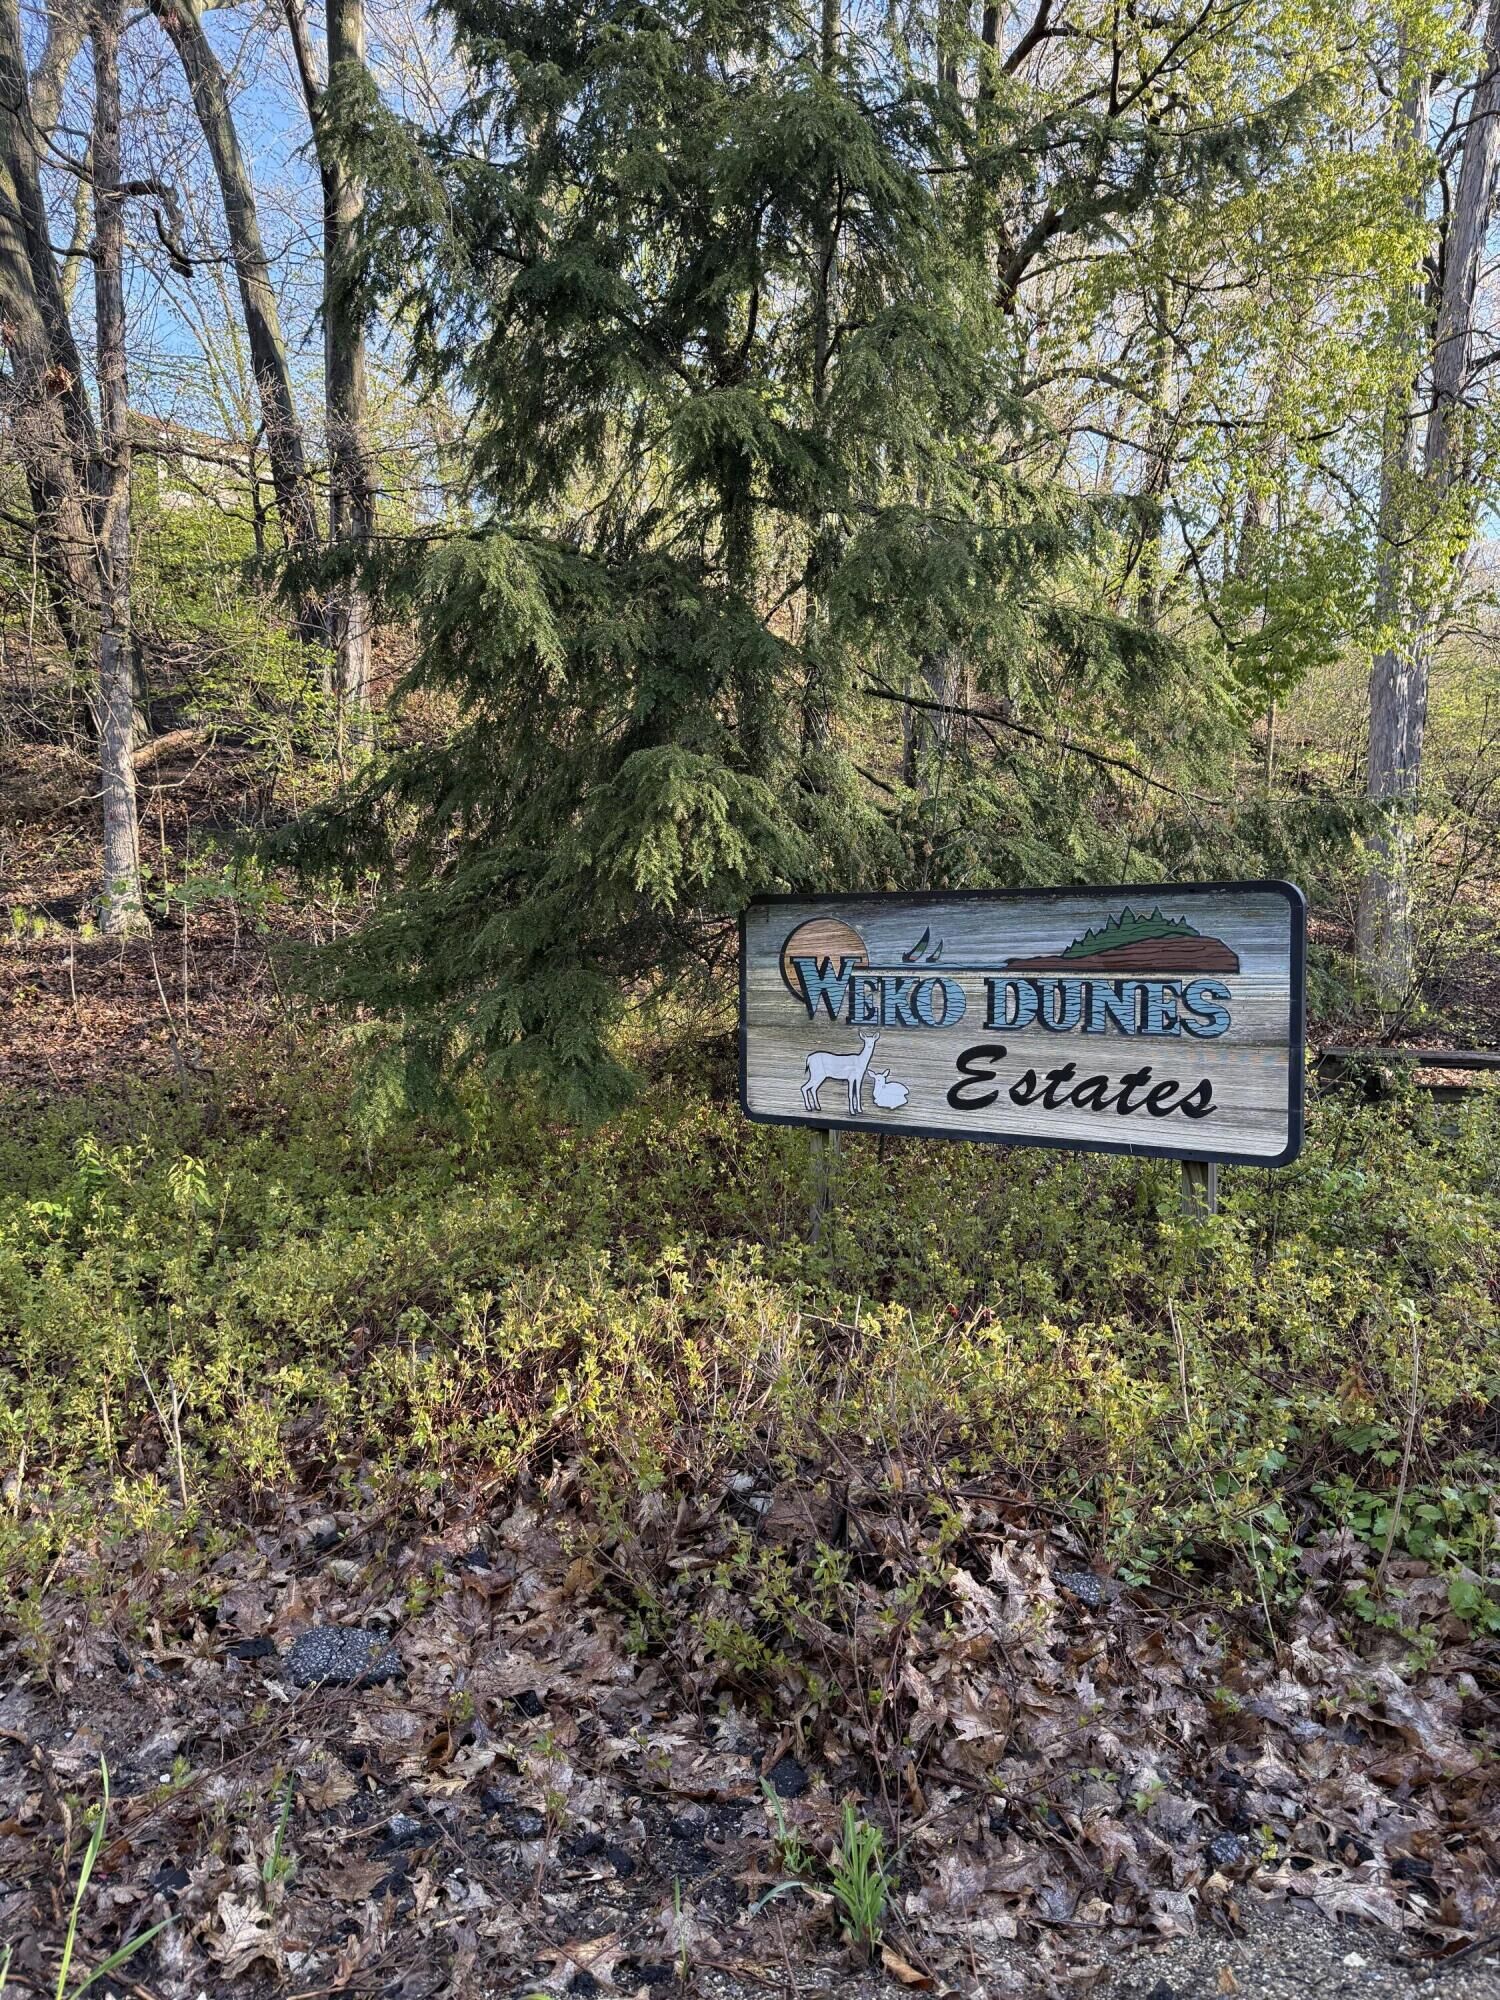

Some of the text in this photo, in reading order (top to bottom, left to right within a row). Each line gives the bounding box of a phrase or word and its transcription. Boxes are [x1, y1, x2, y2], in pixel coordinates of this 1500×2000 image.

[789, 955, 1232, 1039] WEKO DUNES
[946, 1044, 1218, 1119] Estates
